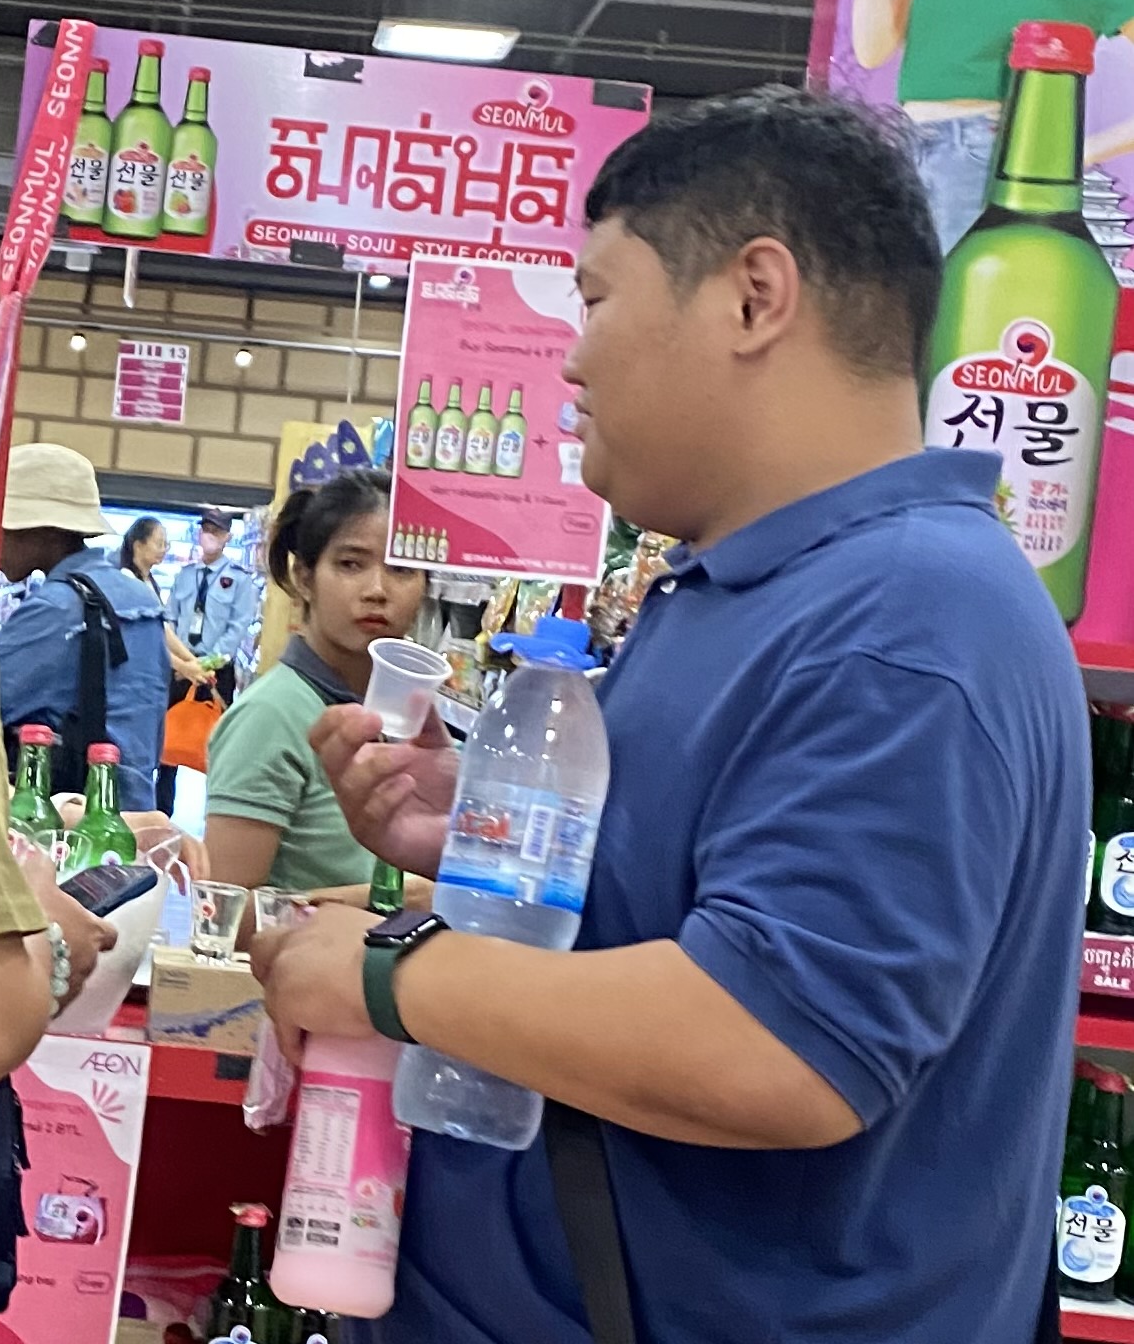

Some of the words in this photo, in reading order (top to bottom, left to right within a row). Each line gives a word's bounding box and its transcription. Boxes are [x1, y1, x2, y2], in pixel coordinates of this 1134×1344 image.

[480, 105, 567, 134] SEONMUL
[116, 160, 159, 187] 선물
[1, 140, 56, 283] SEONMUL
[347, 234, 396, 254] SOJU
[169, 347, 186, 360] 13
[960, 364, 1068, 394] SEONMUL
[942, 392, 1080, 467] 선물
[1094, 974, 1131, 991] SALE
[1065, 1212, 1118, 1244] 선물
